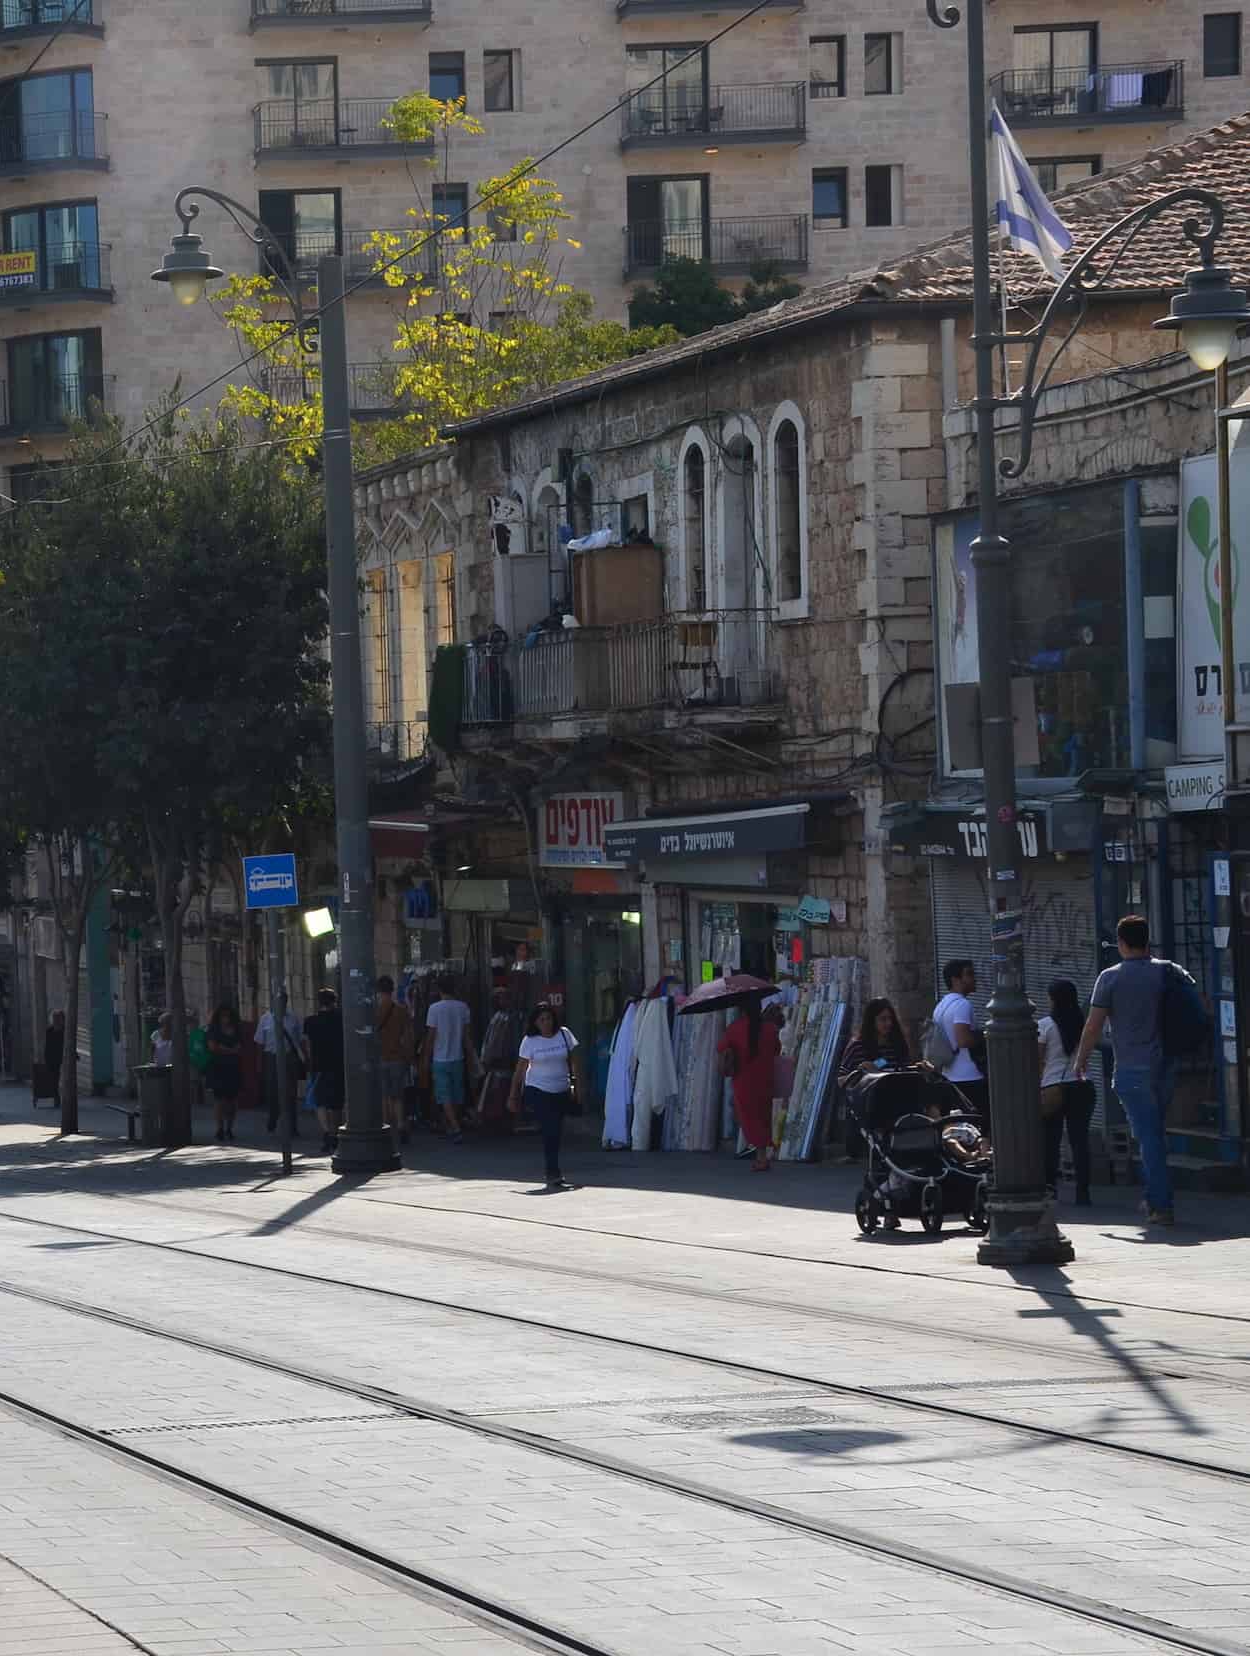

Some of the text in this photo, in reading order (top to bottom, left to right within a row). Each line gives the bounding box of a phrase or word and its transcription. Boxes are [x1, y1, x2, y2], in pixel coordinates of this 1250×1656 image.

[6, 255, 32, 271] RENT
[1167, 774, 1225, 798] CAMPING S
[660, 835, 680, 853] בדים
